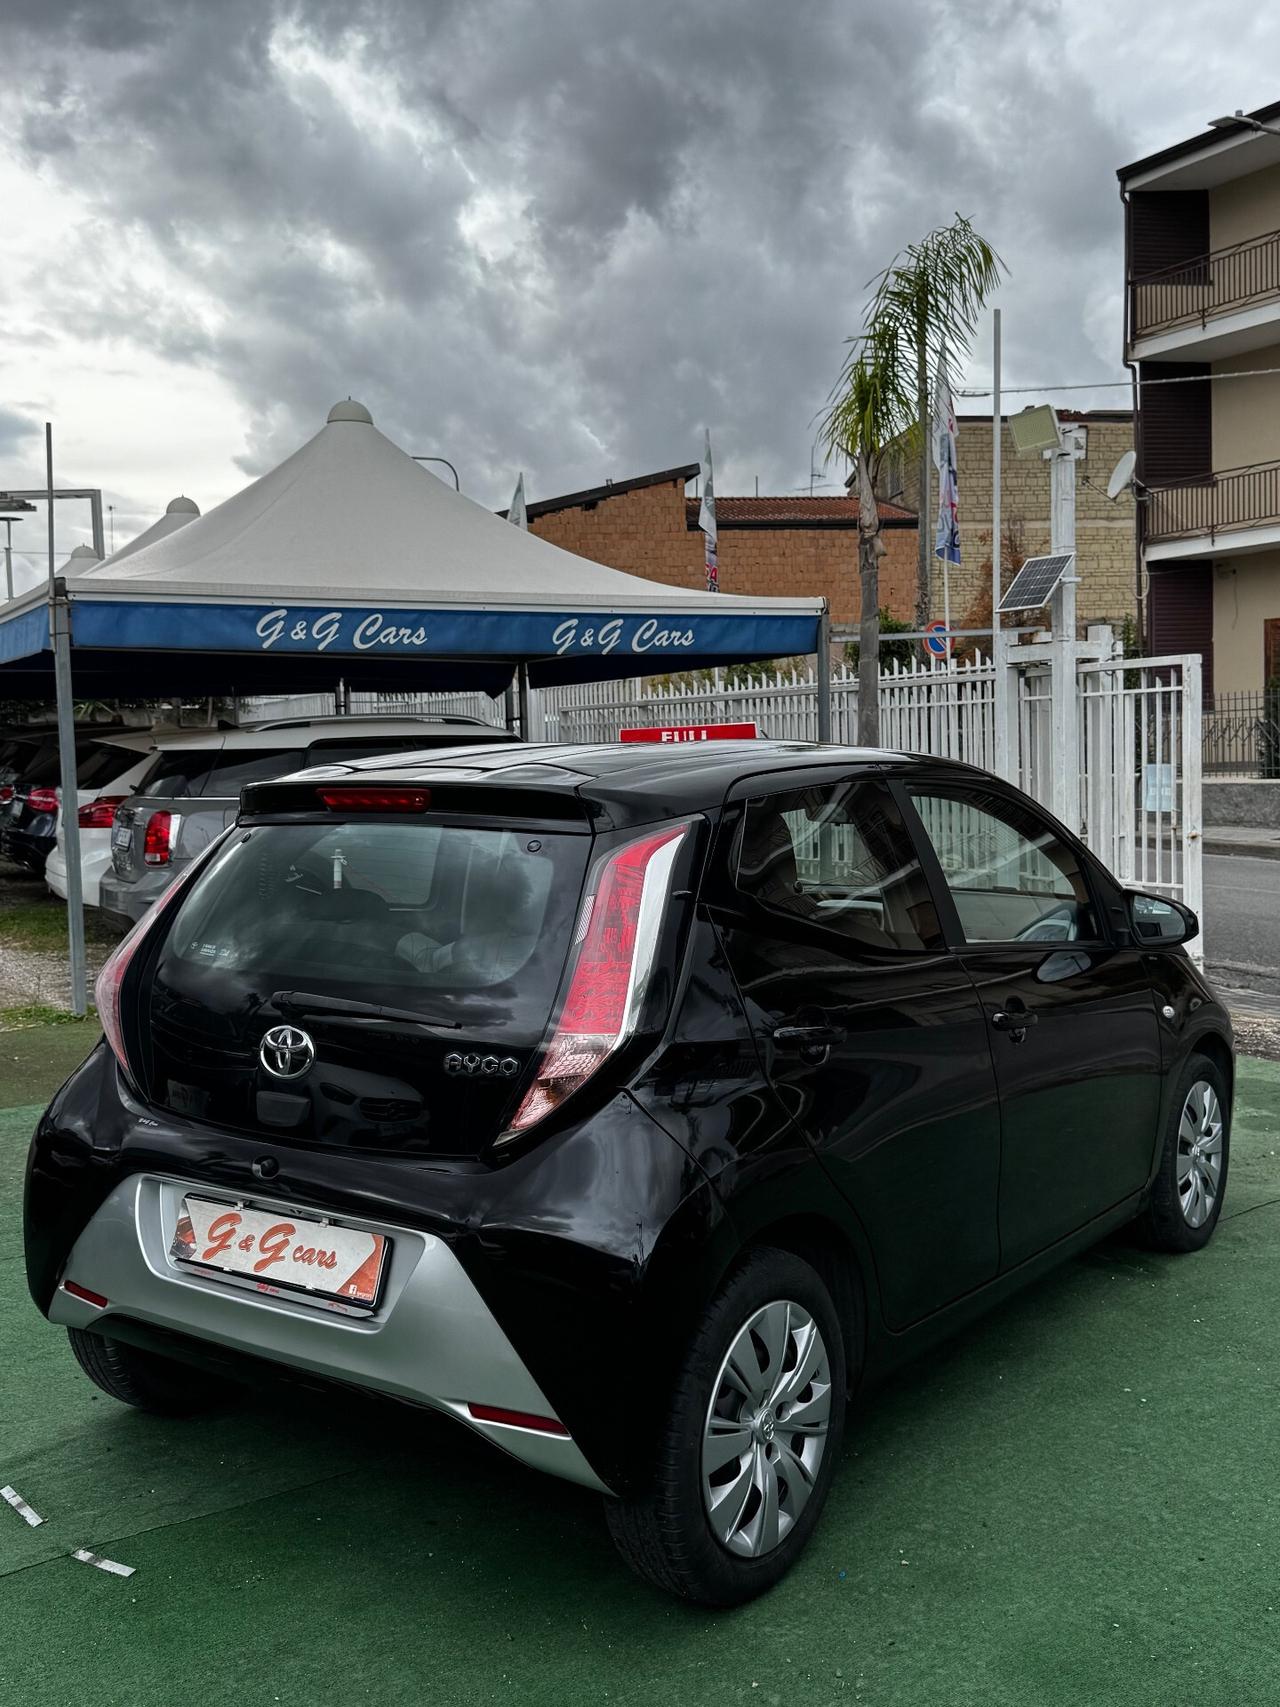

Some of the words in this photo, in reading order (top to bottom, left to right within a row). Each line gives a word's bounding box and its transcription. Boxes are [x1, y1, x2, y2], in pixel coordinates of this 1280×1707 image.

[353, 613, 428, 650] Cars
[632, 618, 695, 653] Cars
[444, 1052, 520, 1077] AYGO
[292, 1245, 338, 1269] cars
